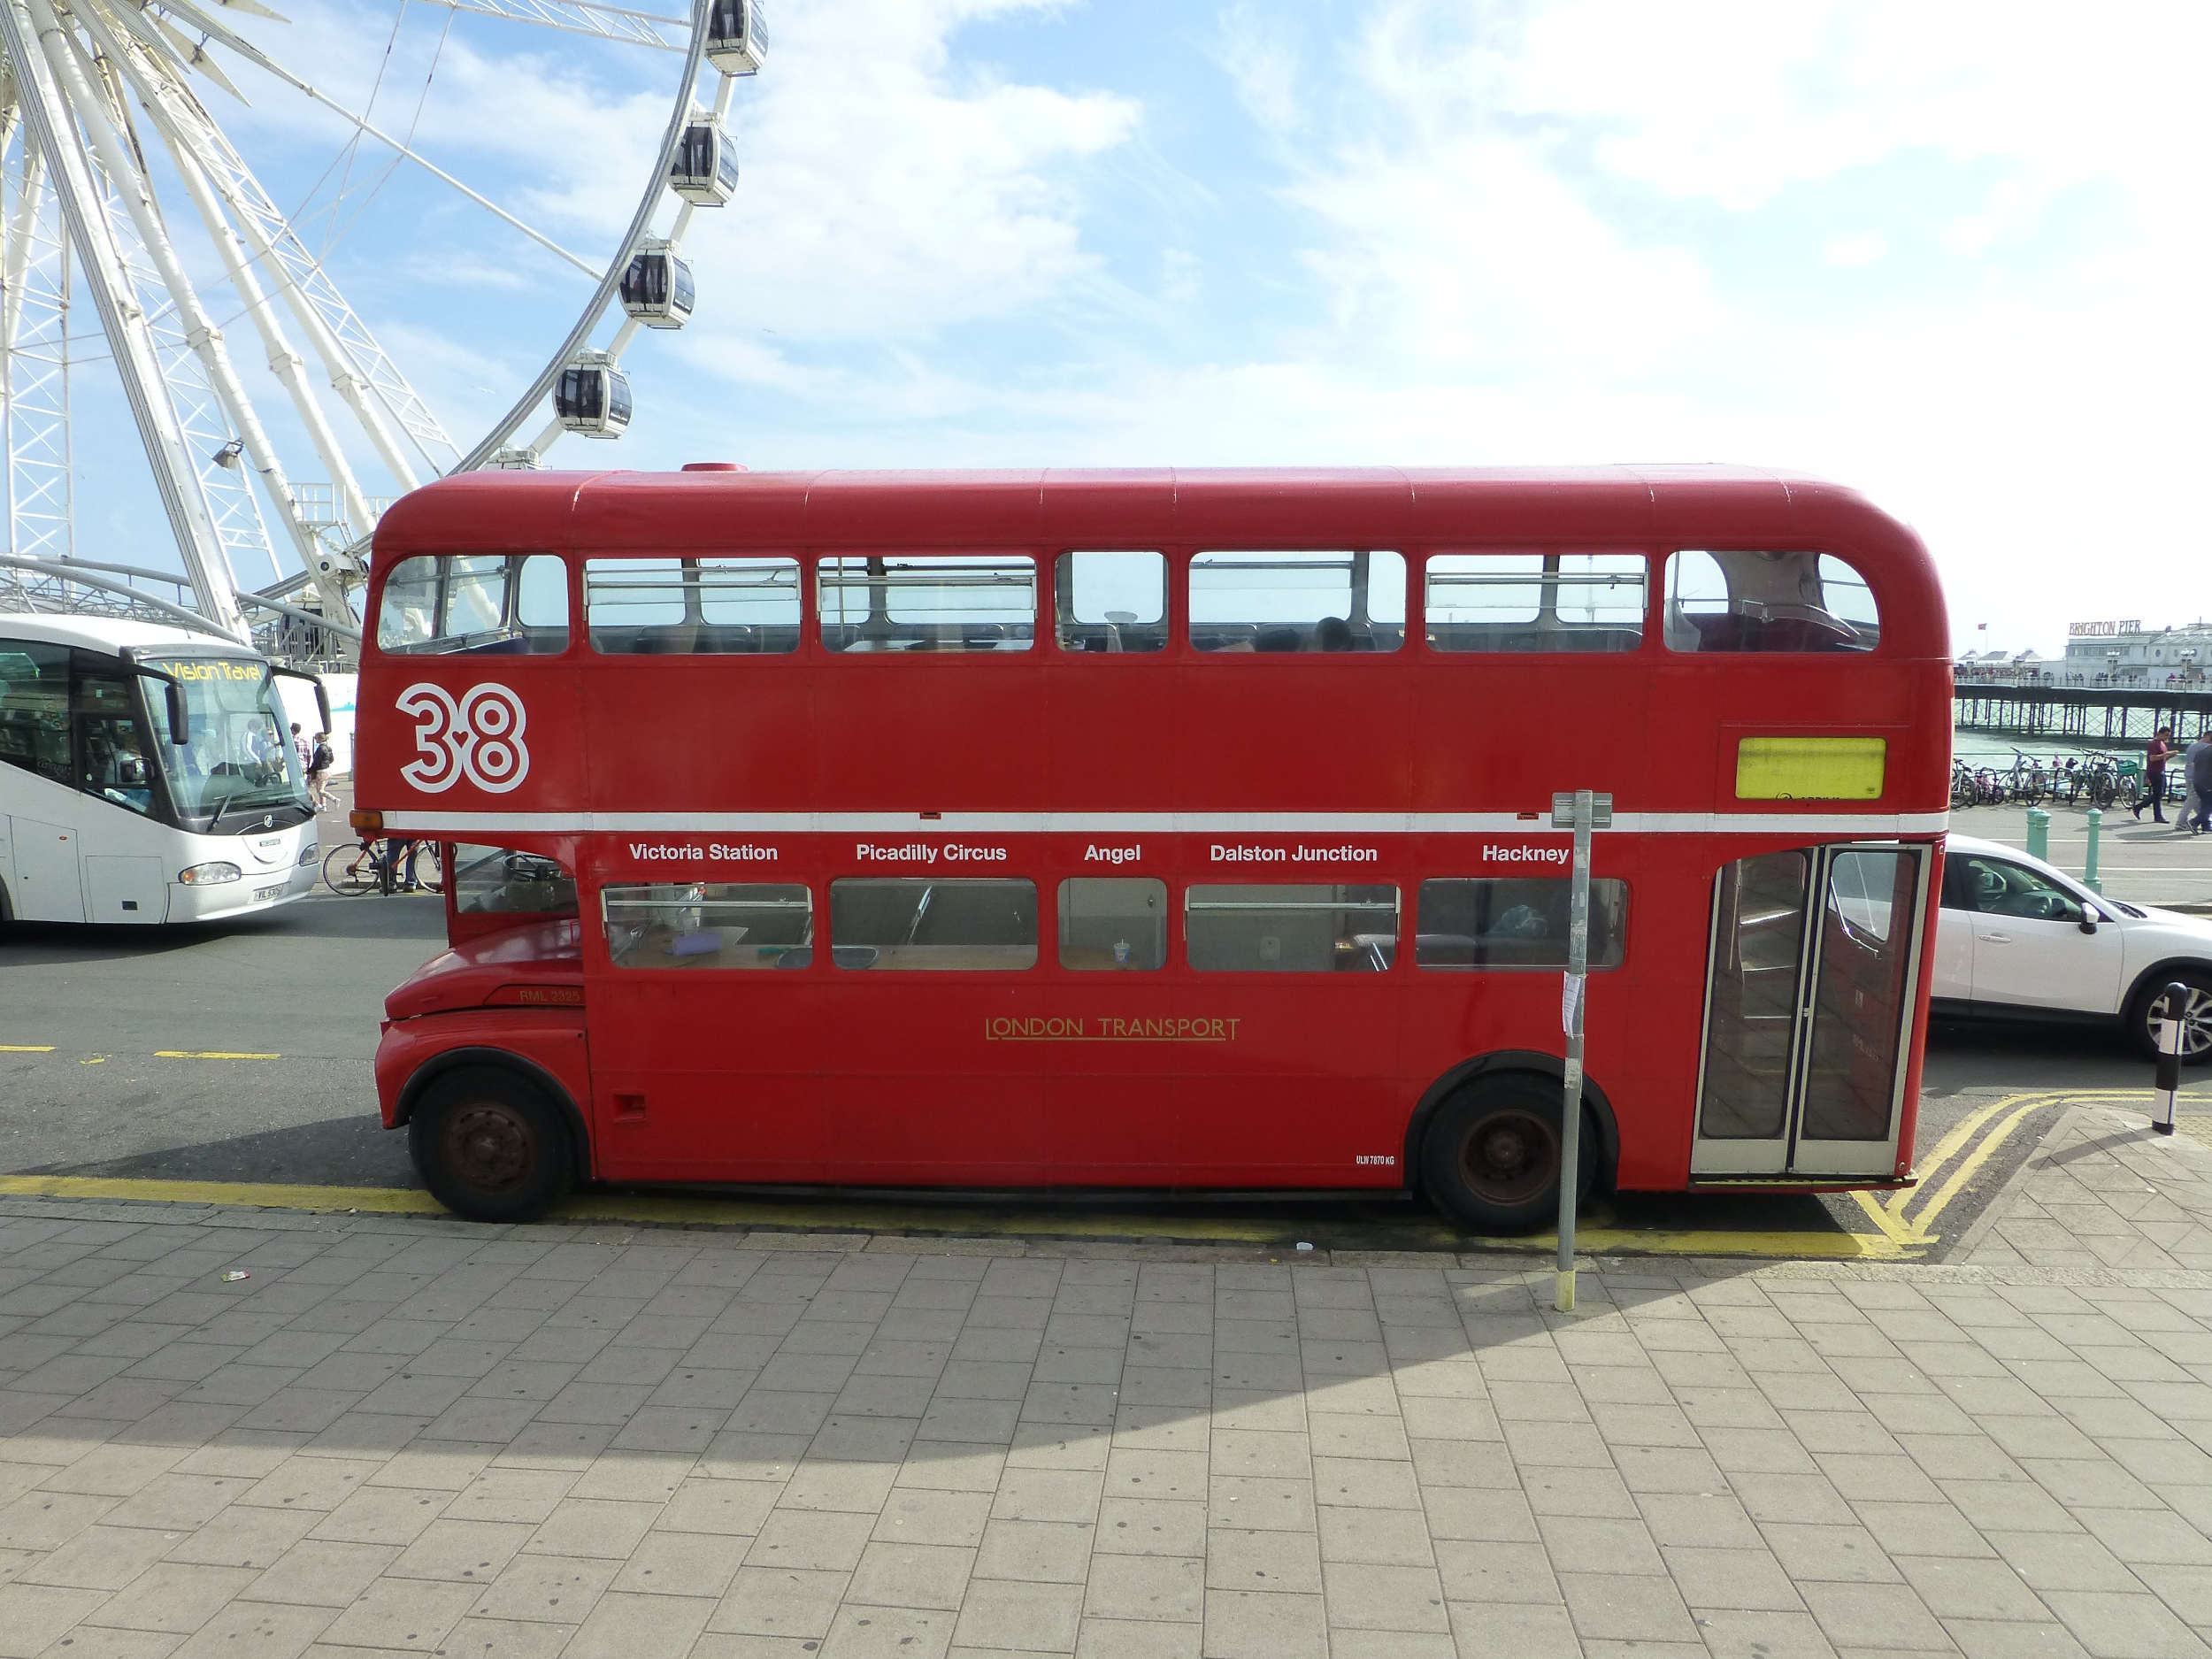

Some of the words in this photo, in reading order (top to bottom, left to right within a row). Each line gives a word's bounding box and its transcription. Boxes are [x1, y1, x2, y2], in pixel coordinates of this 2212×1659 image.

[2069, 621, 2116, 636] BRIGHTON
[2118, 619, 2141, 636] PIER
[162, 662, 220, 680] Vision
[218, 661, 264, 680] Travel
[395, 682, 530, 794] 38
[628, 843, 704, 860] Victoria
[709, 843, 779, 861] Station
[856, 843, 939, 865] Picadilly
[943, 843, 1007, 861] Circus
[1084, 844, 1141, 865] Angel
[1210, 844, 1286, 862] Dalston
[1291, 844, 1378, 862] Junction
[1482, 844, 1570, 865] Hackney
[518, 990, 548, 1002] RML
[986, 1018, 1084, 1040] LONDON
[1097, 1018, 1241, 1041] TRANSPORT
[1356, 1155, 1370, 1165] ULW
[1370, 1155, 1385, 1165] 7870
[1385, 1155, 1395, 1166] KG
